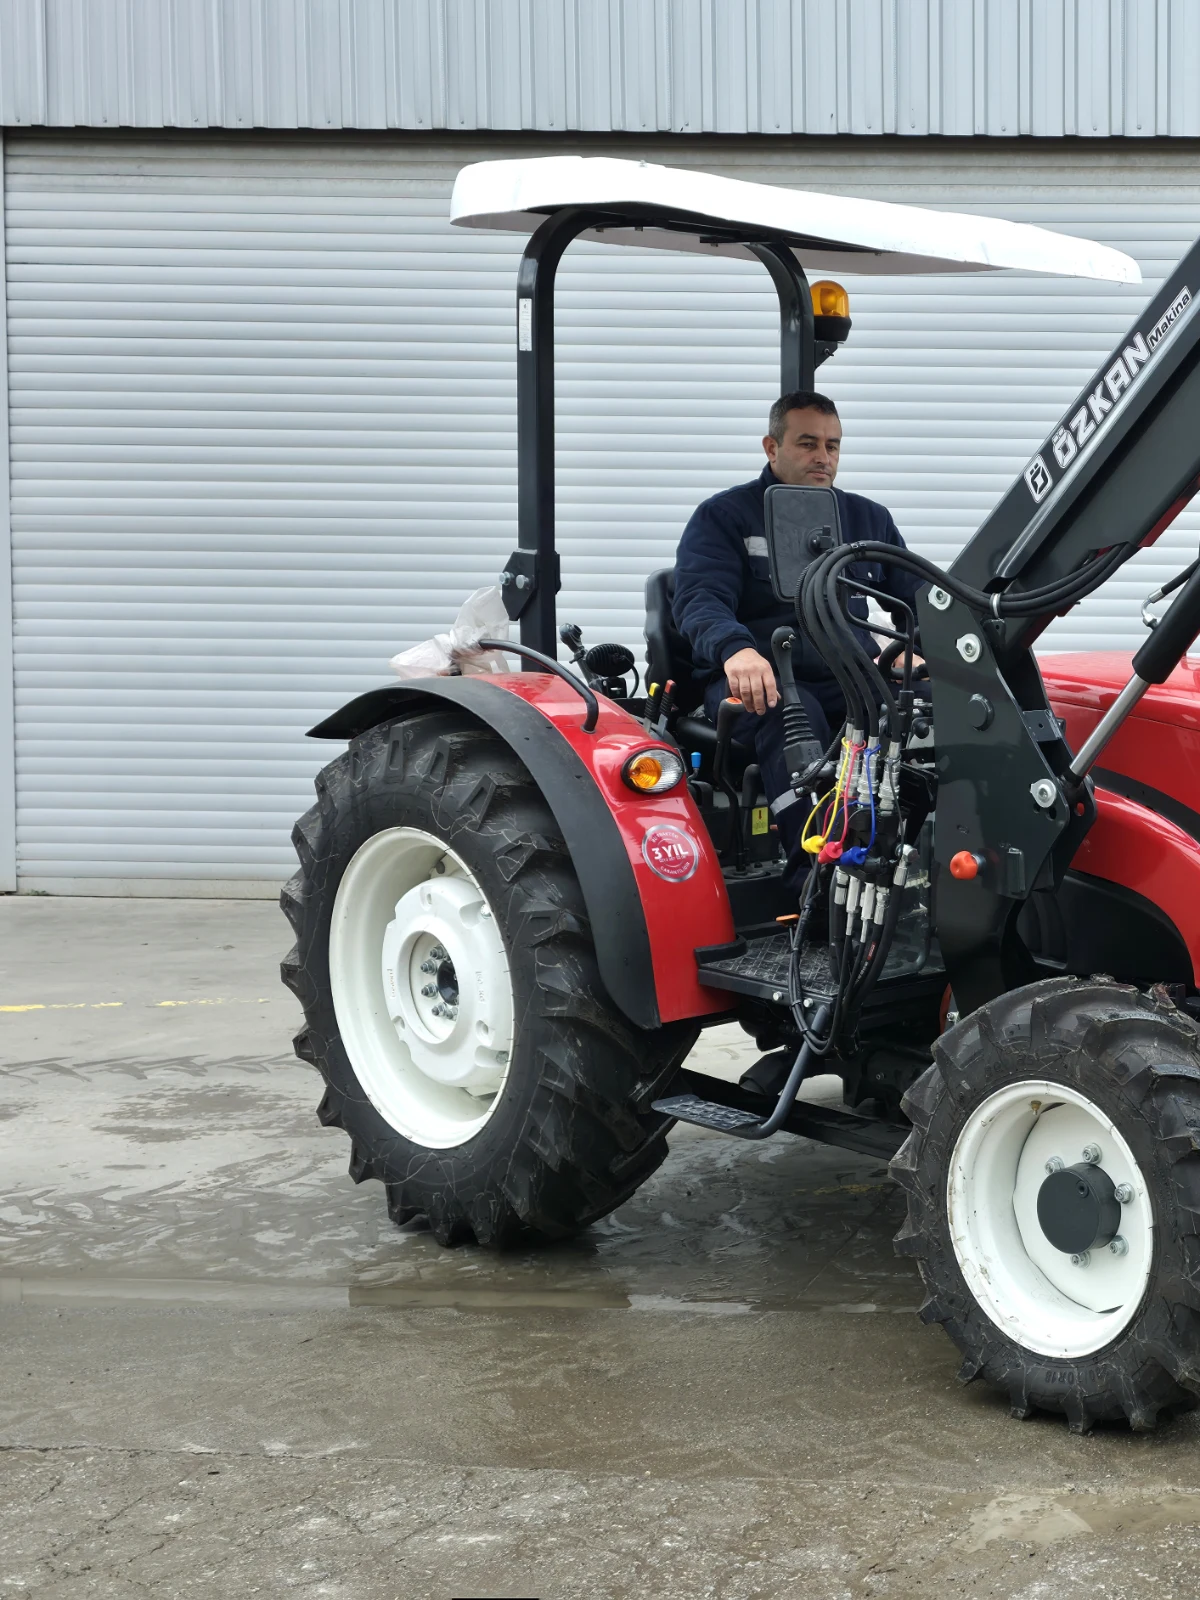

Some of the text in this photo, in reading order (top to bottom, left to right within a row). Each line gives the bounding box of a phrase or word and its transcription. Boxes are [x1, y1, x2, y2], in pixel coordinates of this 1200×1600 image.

[1052, 332, 1150, 468] ÖZKAN
[1149, 292, 1191, 348] Makina
[652, 847, 662, 860] 3
[662, 844, 689, 858] YIL
